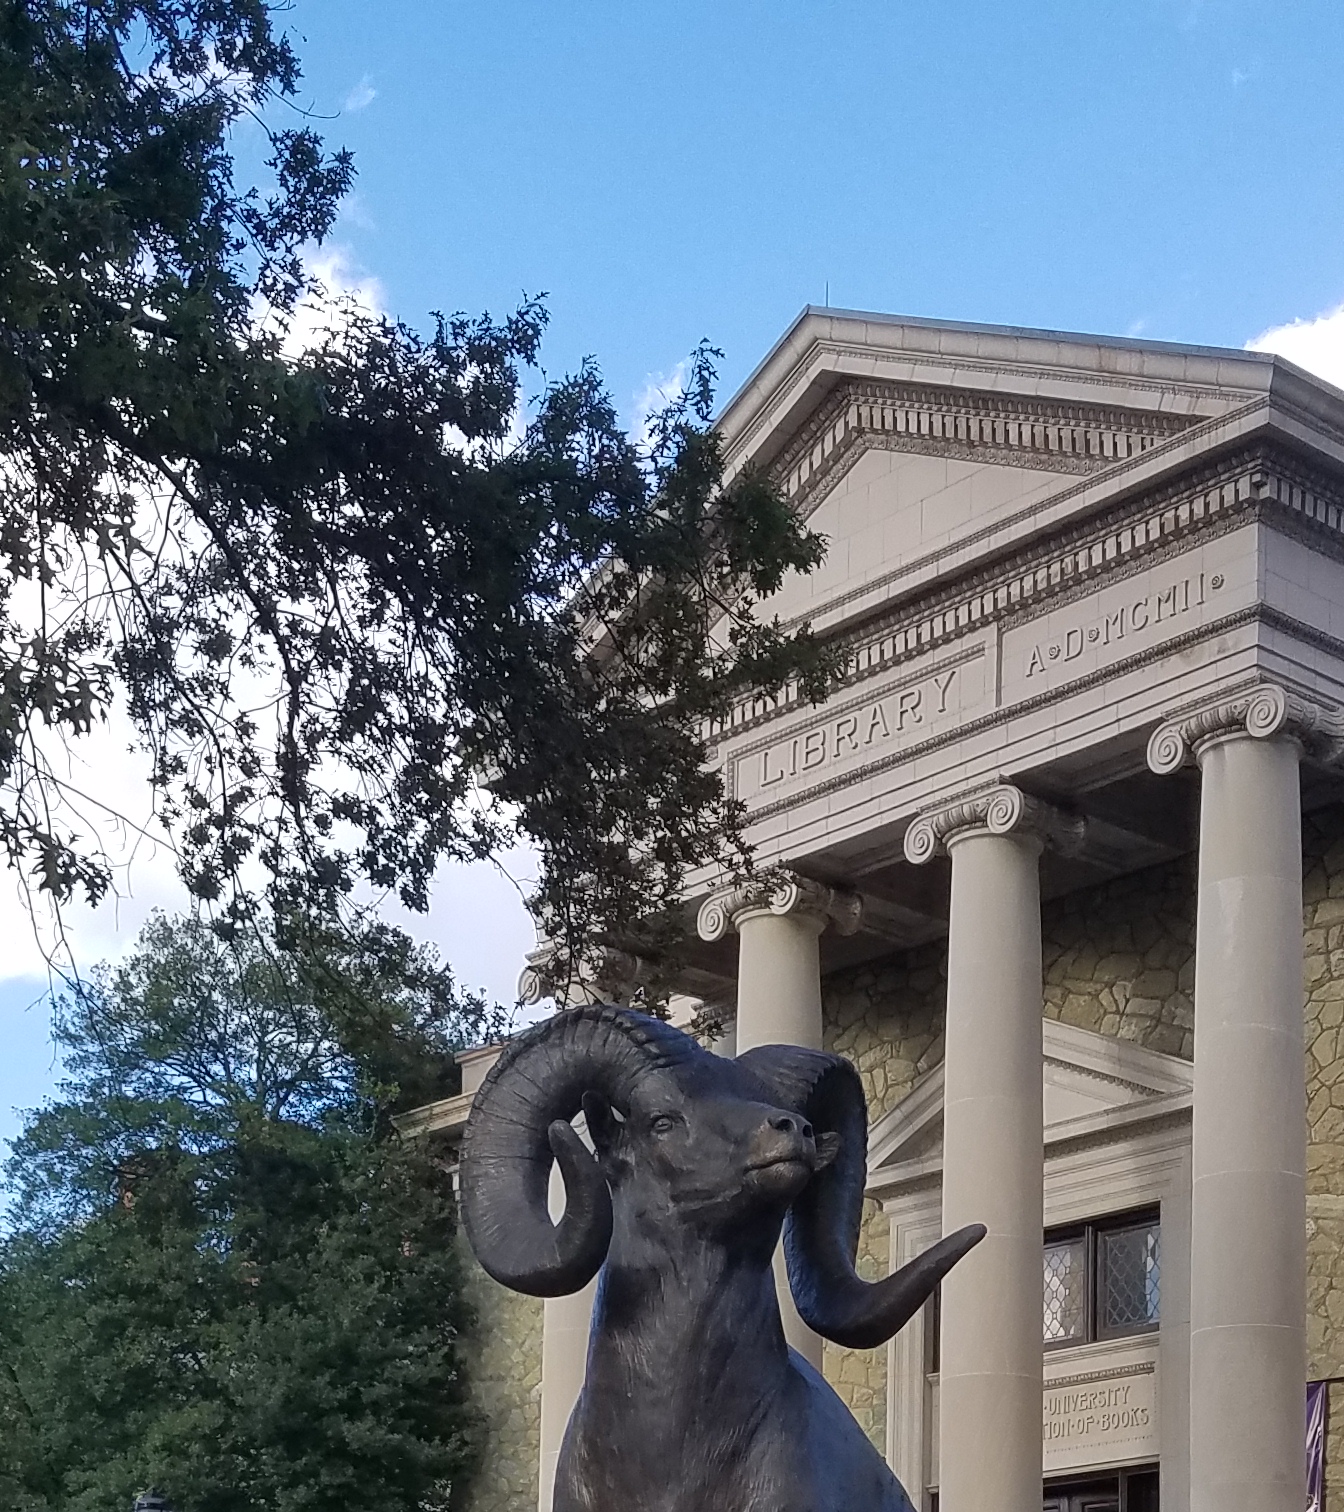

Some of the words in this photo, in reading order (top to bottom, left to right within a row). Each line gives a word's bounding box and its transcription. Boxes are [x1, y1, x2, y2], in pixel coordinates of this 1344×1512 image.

[760, 670, 957, 788] LIBRARY
[1049, 1385, 1131, 1416] UNIVERSITY
[1077, 1415, 1095, 1435] OF
[1101, 1407, 1150, 1432] BOOKS
